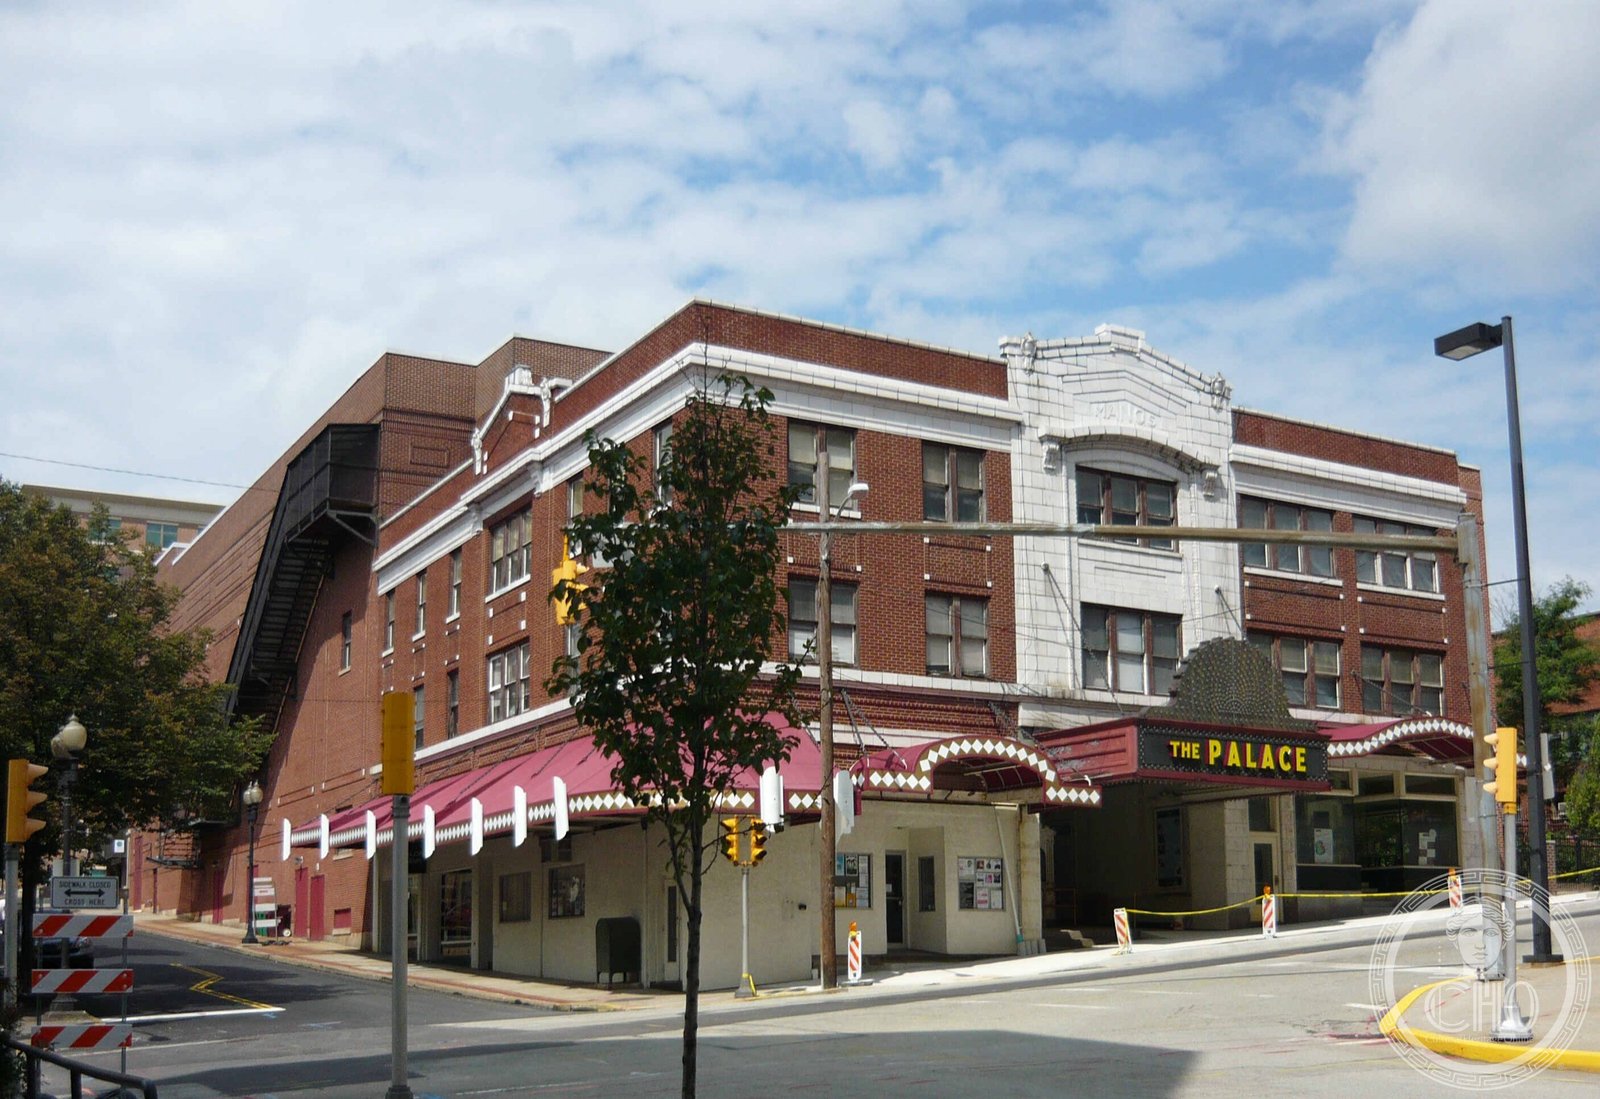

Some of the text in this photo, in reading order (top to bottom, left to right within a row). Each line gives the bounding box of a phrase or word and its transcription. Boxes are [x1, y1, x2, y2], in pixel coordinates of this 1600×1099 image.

[1094, 403, 1157, 429] MANOS
[1169, 739, 1307, 772] THE PALACE
[59, 881, 112, 889] SIDEWALK CLOSED
[64, 898, 105, 906] CROSS HERE
